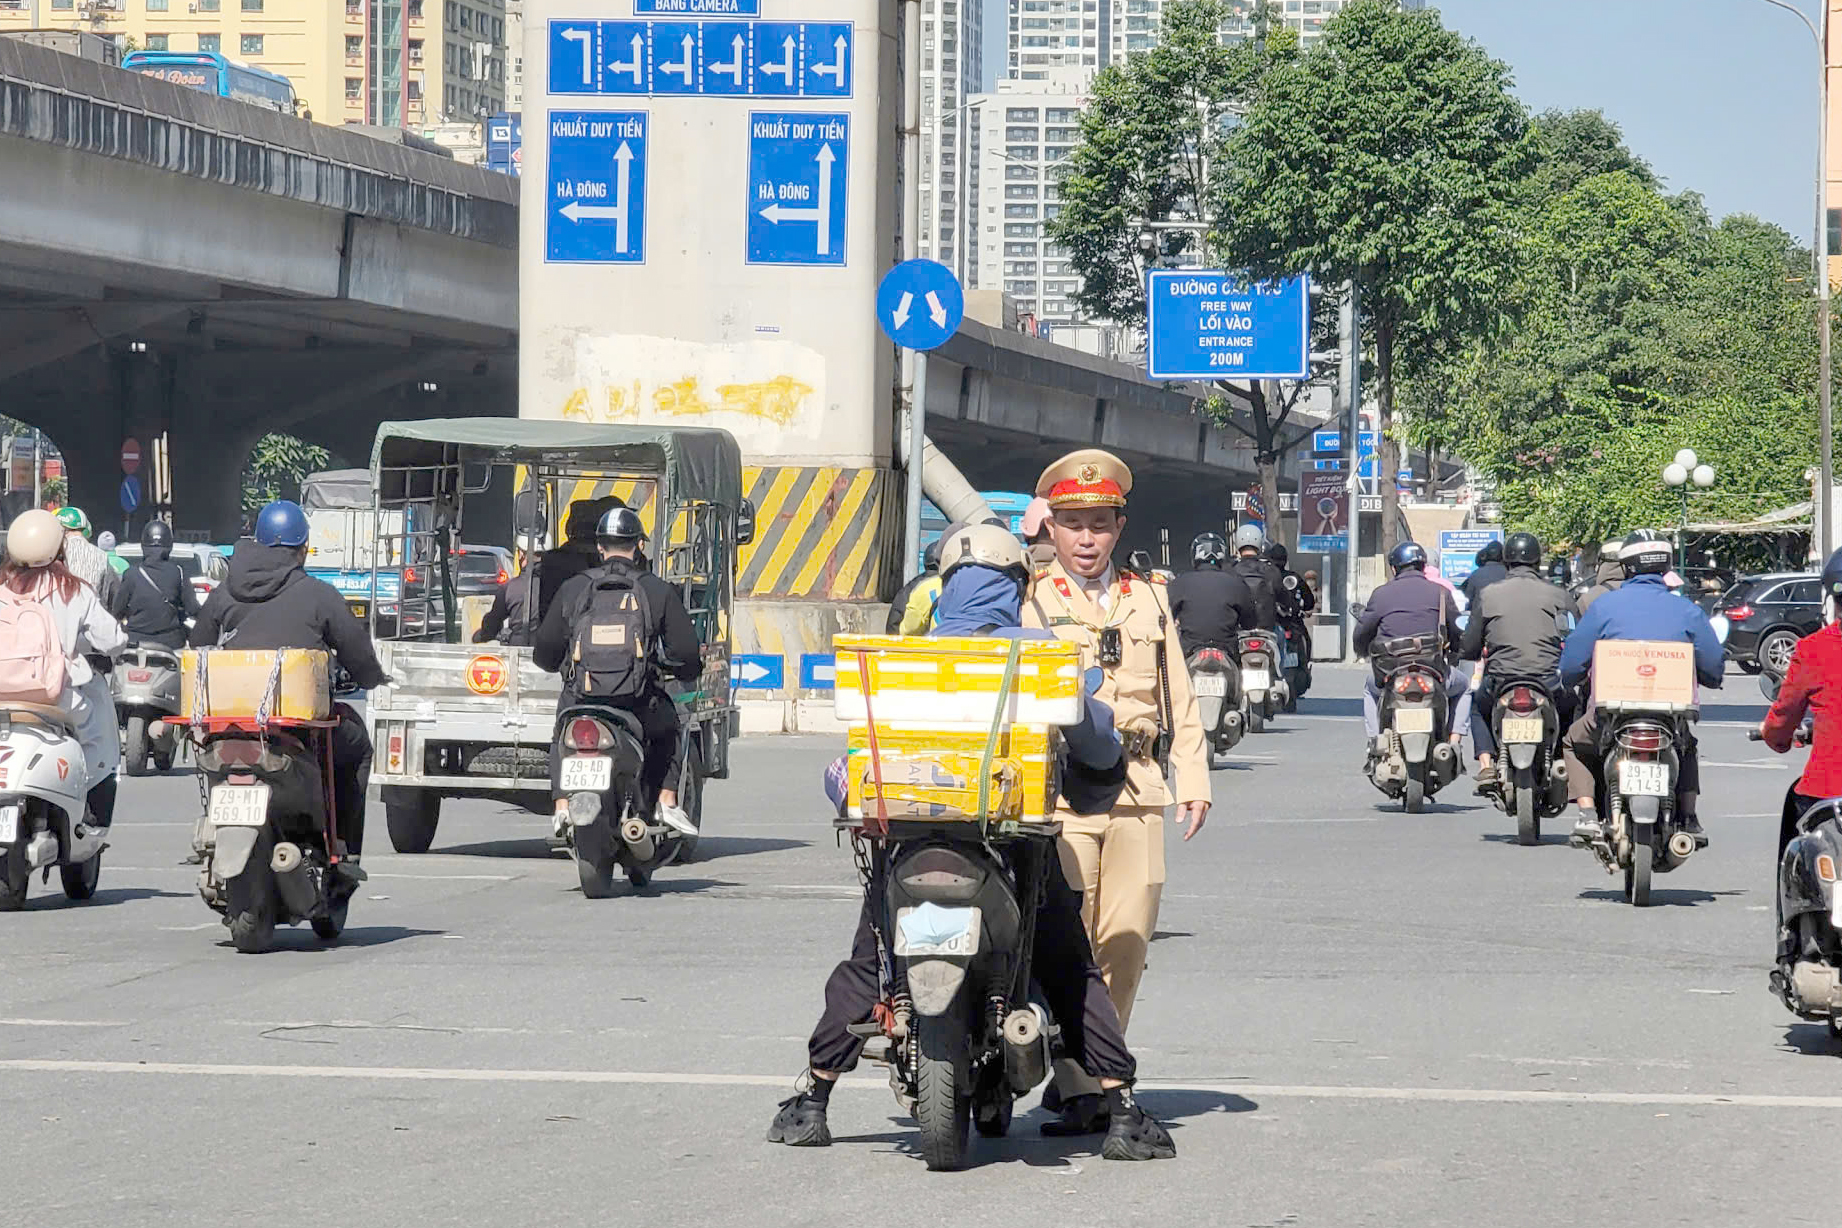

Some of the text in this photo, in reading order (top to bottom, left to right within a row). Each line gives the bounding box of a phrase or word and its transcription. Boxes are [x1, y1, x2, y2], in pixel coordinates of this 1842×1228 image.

[690, 0, 739, 12] CAMERA
[552, 116, 643, 138] KHUẤT DUY TIẾN
[753, 117, 845, 139] KHUẤT DUY TIẾN
[557, 178, 607, 198] HÀ ĐÔNG
[759, 180, 810, 200] HÀ ĐÔNG
[1170, 279, 1217, 295] ĐƯỜNG
[1200, 301, 1252, 311] FREE WAY
[1200, 313, 1252, 330] LỐI VÀO
[1199, 336, 1253, 347] ENTRANCE
[1209, 352, 1244, 366] 200M
[1305, 486, 1330, 495] LIGHT
[1643, 649, 1686, 660] VENUSIA
[564, 773, 606, 787] 346.71
[212, 806, 262, 822] 569.10
